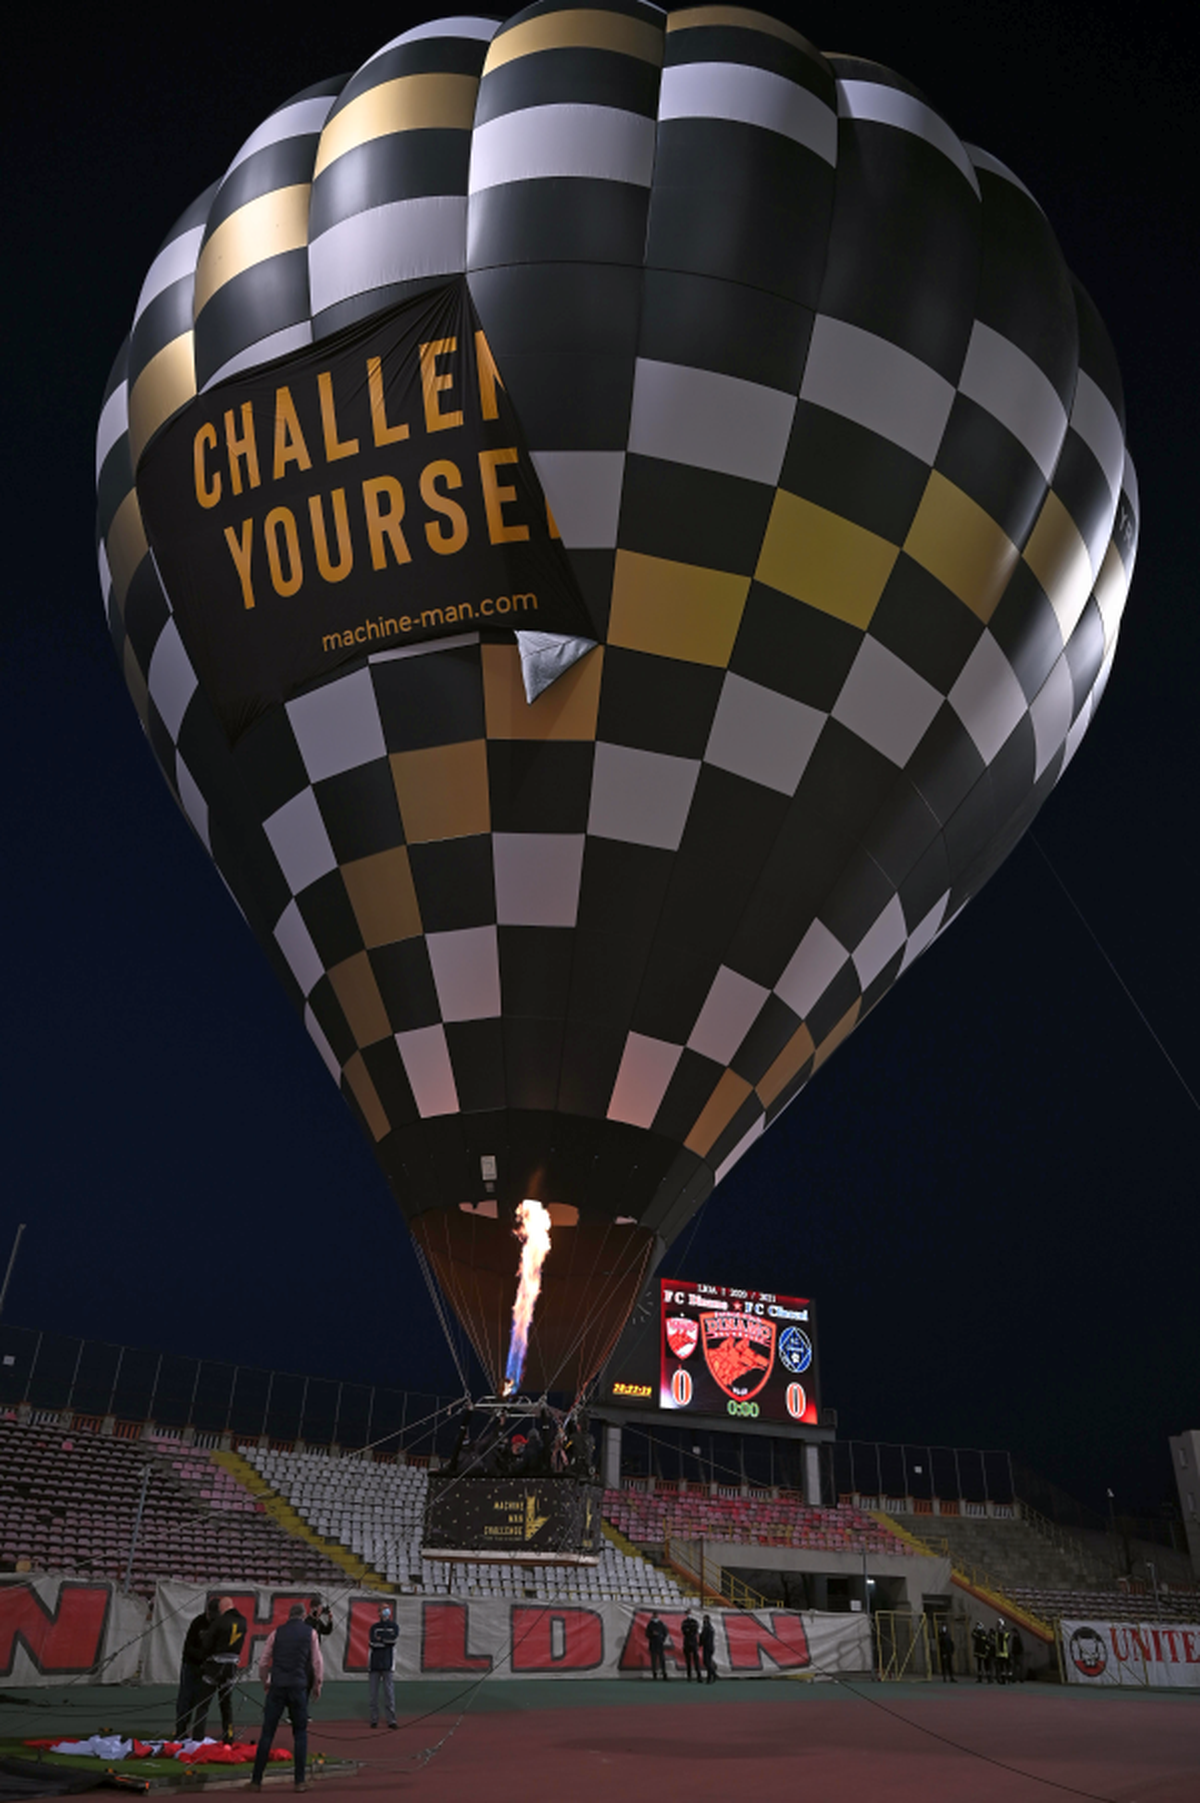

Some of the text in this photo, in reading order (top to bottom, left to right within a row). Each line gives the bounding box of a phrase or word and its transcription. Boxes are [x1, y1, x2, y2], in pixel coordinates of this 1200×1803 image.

[223, 447, 562, 610] YOURSE
[321, 591, 539, 652] machine-man.com
[705, 1317, 772, 1341] DINAMO
[671, 1369, 693, 1406] 0
[785, 1382, 807, 1419] 0
[493, 1500, 524, 1511] MACHINE
[484, 1525, 524, 1536] CHALLENGE
